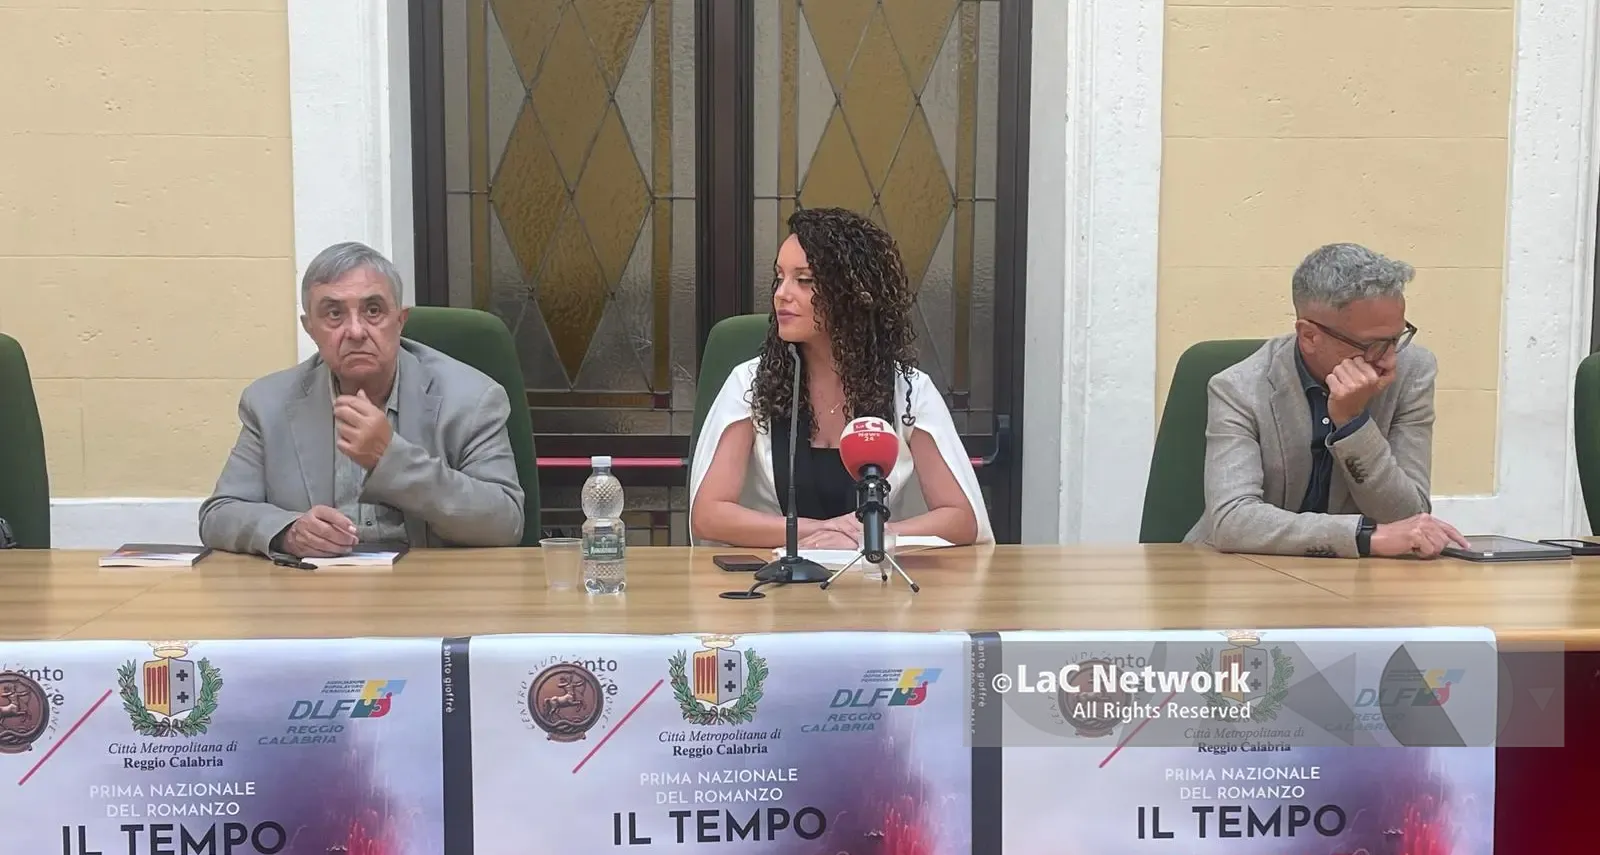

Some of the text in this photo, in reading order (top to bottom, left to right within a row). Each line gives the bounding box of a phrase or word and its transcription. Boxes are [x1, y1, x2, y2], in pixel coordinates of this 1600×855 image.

[443, 645, 455, 713] santo gioffrè
[829, 688, 894, 708] DLF
[288, 700, 355, 720] DLF
[827, 713, 882, 722] REGGIO
[287, 725, 345, 734] REGGIO
[801, 723, 876, 733] CALABRIA
[1184, 726, 1305, 740] Città Metropolitana di
[258, 736, 337, 746] CALABRIA
[658, 729, 781, 743] Città Metropolitana di
[109, 741, 238, 756] Città Metropolitana di
[673, 743, 768, 758] Reggio Calabria
[1198, 741, 1291, 755] Reggio Calabria
[124, 756, 223, 771] Reggio Calabria
[640, 768, 798, 786] PRIMA NAZIONALE
[1165, 766, 1320, 781] PRIMA NAZIONALE
[90, 782, 256, 798] PRIMA NAZIONALE
[656, 788, 783, 804] DEL ROMANZO
[1180, 785, 1305, 799] DEL ROMANZO
[107, 802, 240, 817] DEL ROMANZO
[613, 807, 827, 845] IL TEMPO
[1138, 804, 1346, 839] IL TEMPO
[62, 821, 287, 855] IL TEMPO
